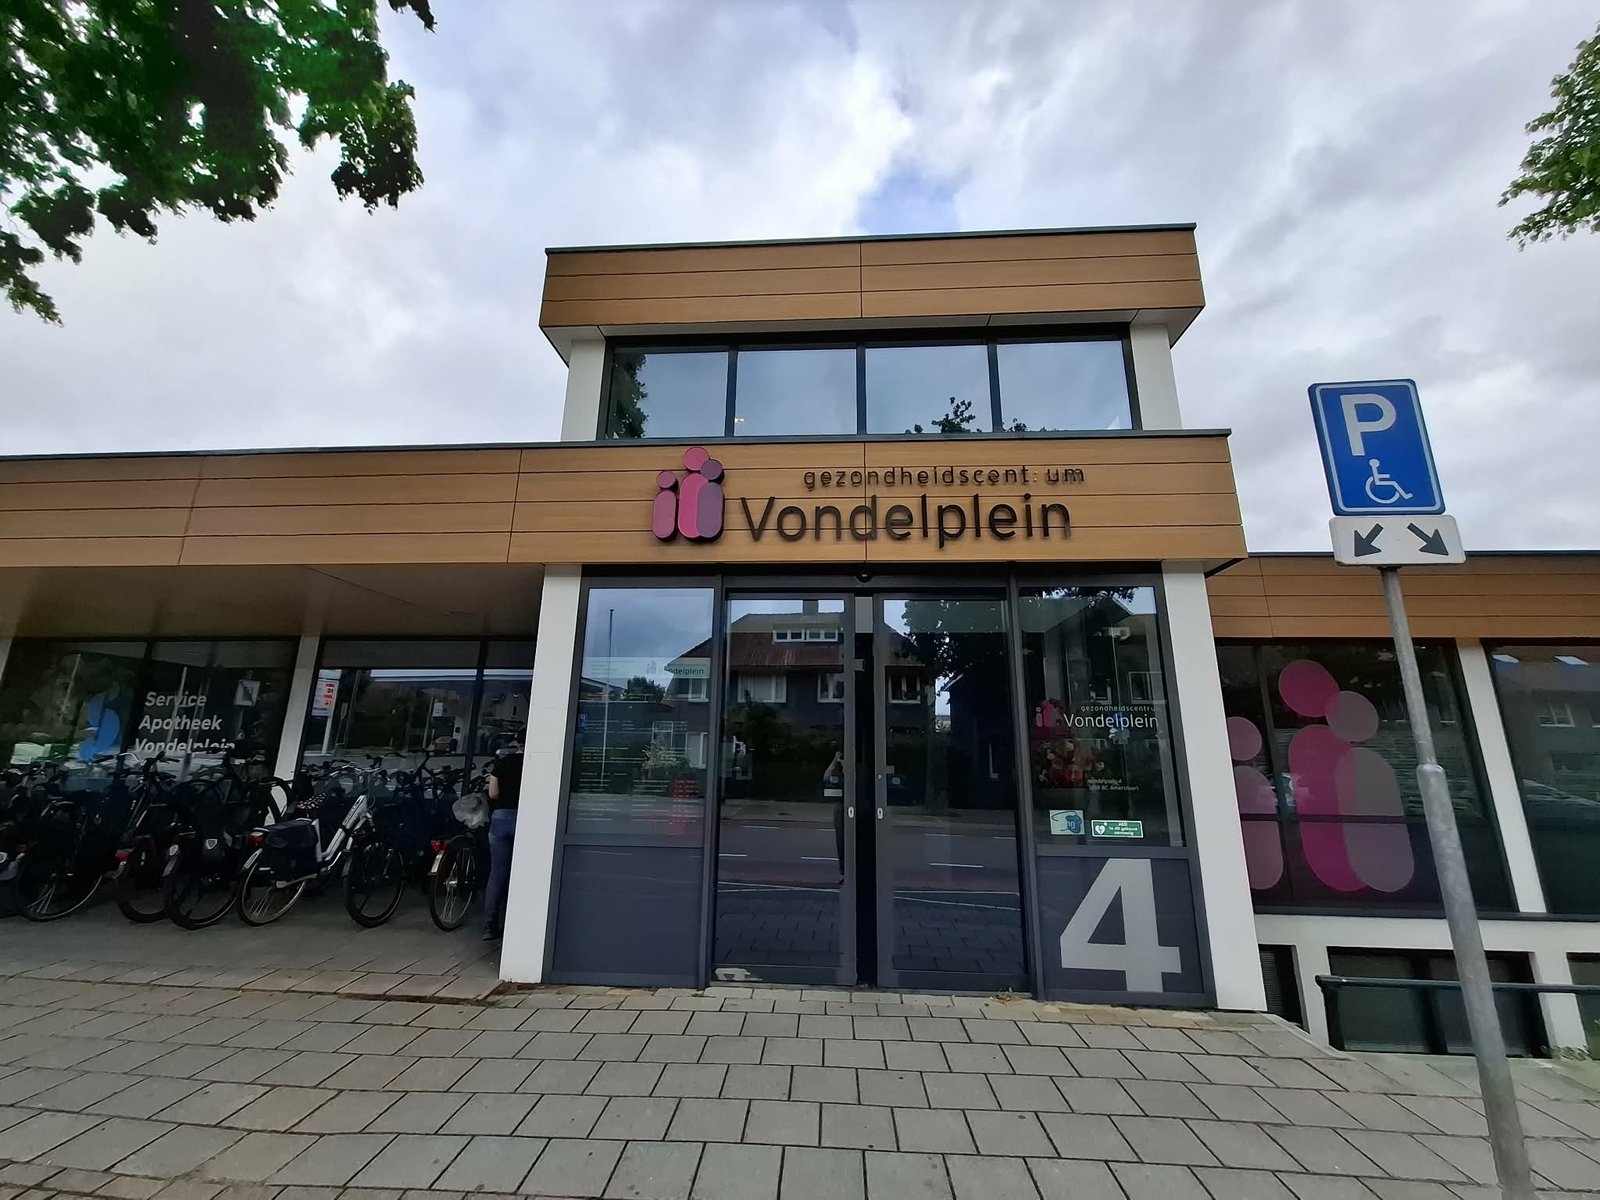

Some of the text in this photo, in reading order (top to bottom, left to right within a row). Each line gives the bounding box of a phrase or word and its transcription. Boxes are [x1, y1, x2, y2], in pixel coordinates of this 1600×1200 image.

[1340, 394, 1397, 457] P
[803, 465, 1084, 490] gezondheidscentum
[740, 493, 1072, 549] Vondelplein
[144, 694, 206, 708] Service
[1080, 705, 1156, 713] gezondheidscentru
[138, 714, 223, 733] Apotheek
[1063, 713, 1159, 730] Vondelplein
[1060, 859, 1181, 993] 4
